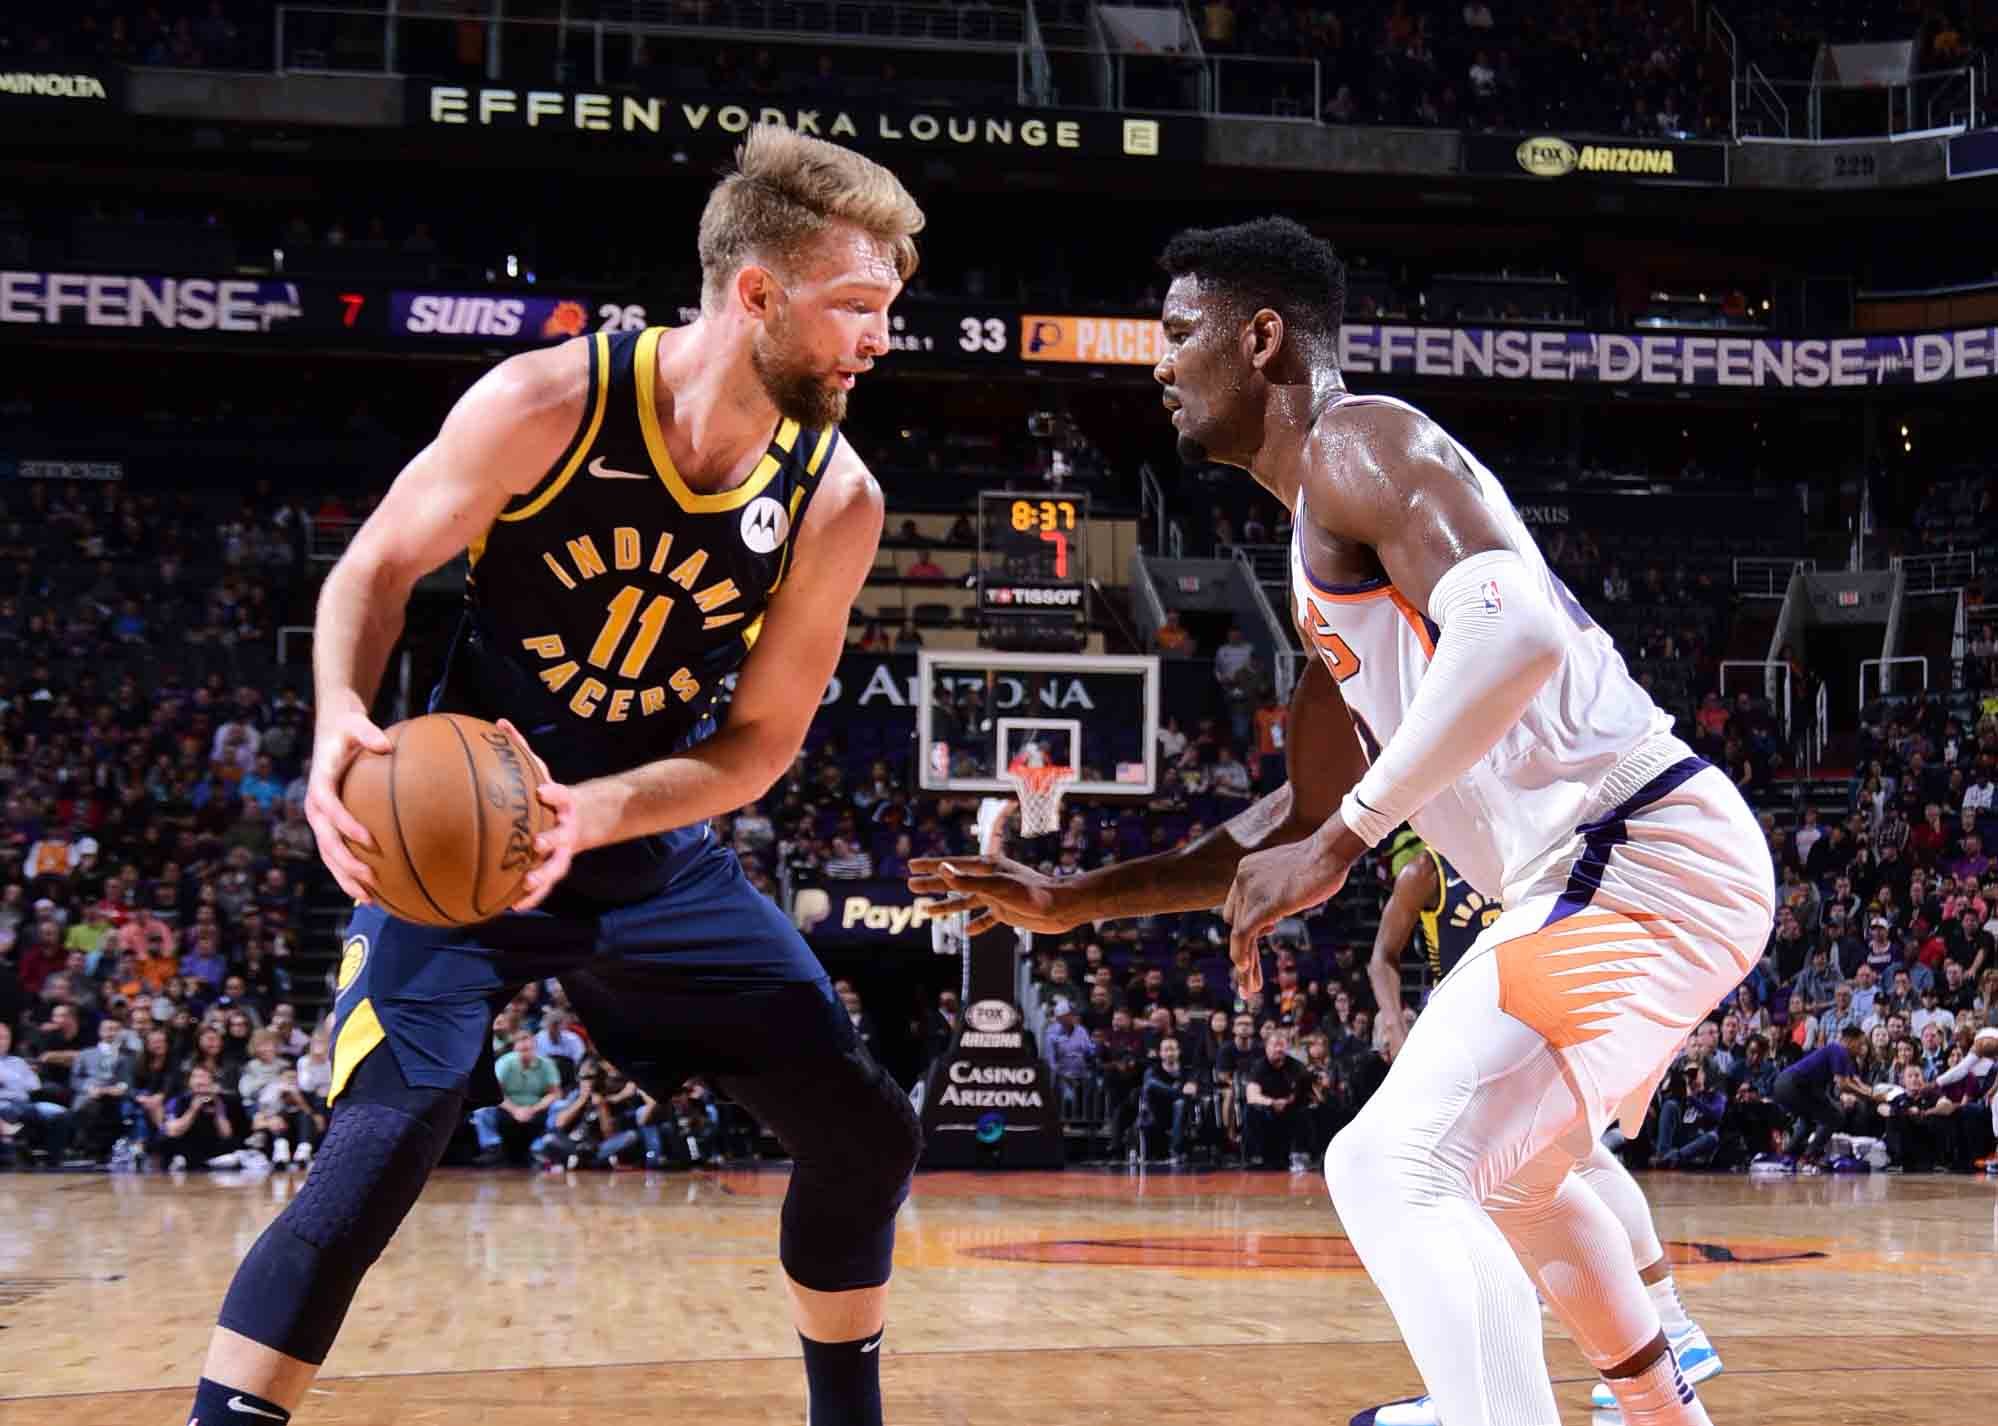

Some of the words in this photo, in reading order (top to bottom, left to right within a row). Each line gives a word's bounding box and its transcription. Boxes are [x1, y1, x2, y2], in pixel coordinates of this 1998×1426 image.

[430, 86, 661, 132] EFFEN
[682, 104, 857, 137] VODKA
[879, 114, 1081, 148] LOUNGE
[1578, 146, 1674, 174] ARIZONA
[0, 271, 258, 331] EFENSE
[339, 294, 366, 329] 7
[599, 304, 647, 333] 26
[959, 317, 1007, 353] 33
[1075, 318, 1164, 362] PACE
[1340, 324, 1566, 381] EFENSE
[1600, 334, 1867, 388] DEFENSE
[1913, 328, 1998, 384] DE
[1011, 500, 1076, 531] 8:37
[1040, 531, 1067, 578] 7
[587, 585, 675, 679] 11
[522, 634, 700, 722] PACERS
[960, 1031, 1022, 1048] ARIZONA
[949, 1060, 1036, 1085] CASINO
[939, 1083, 1043, 1108] ARIZONA
